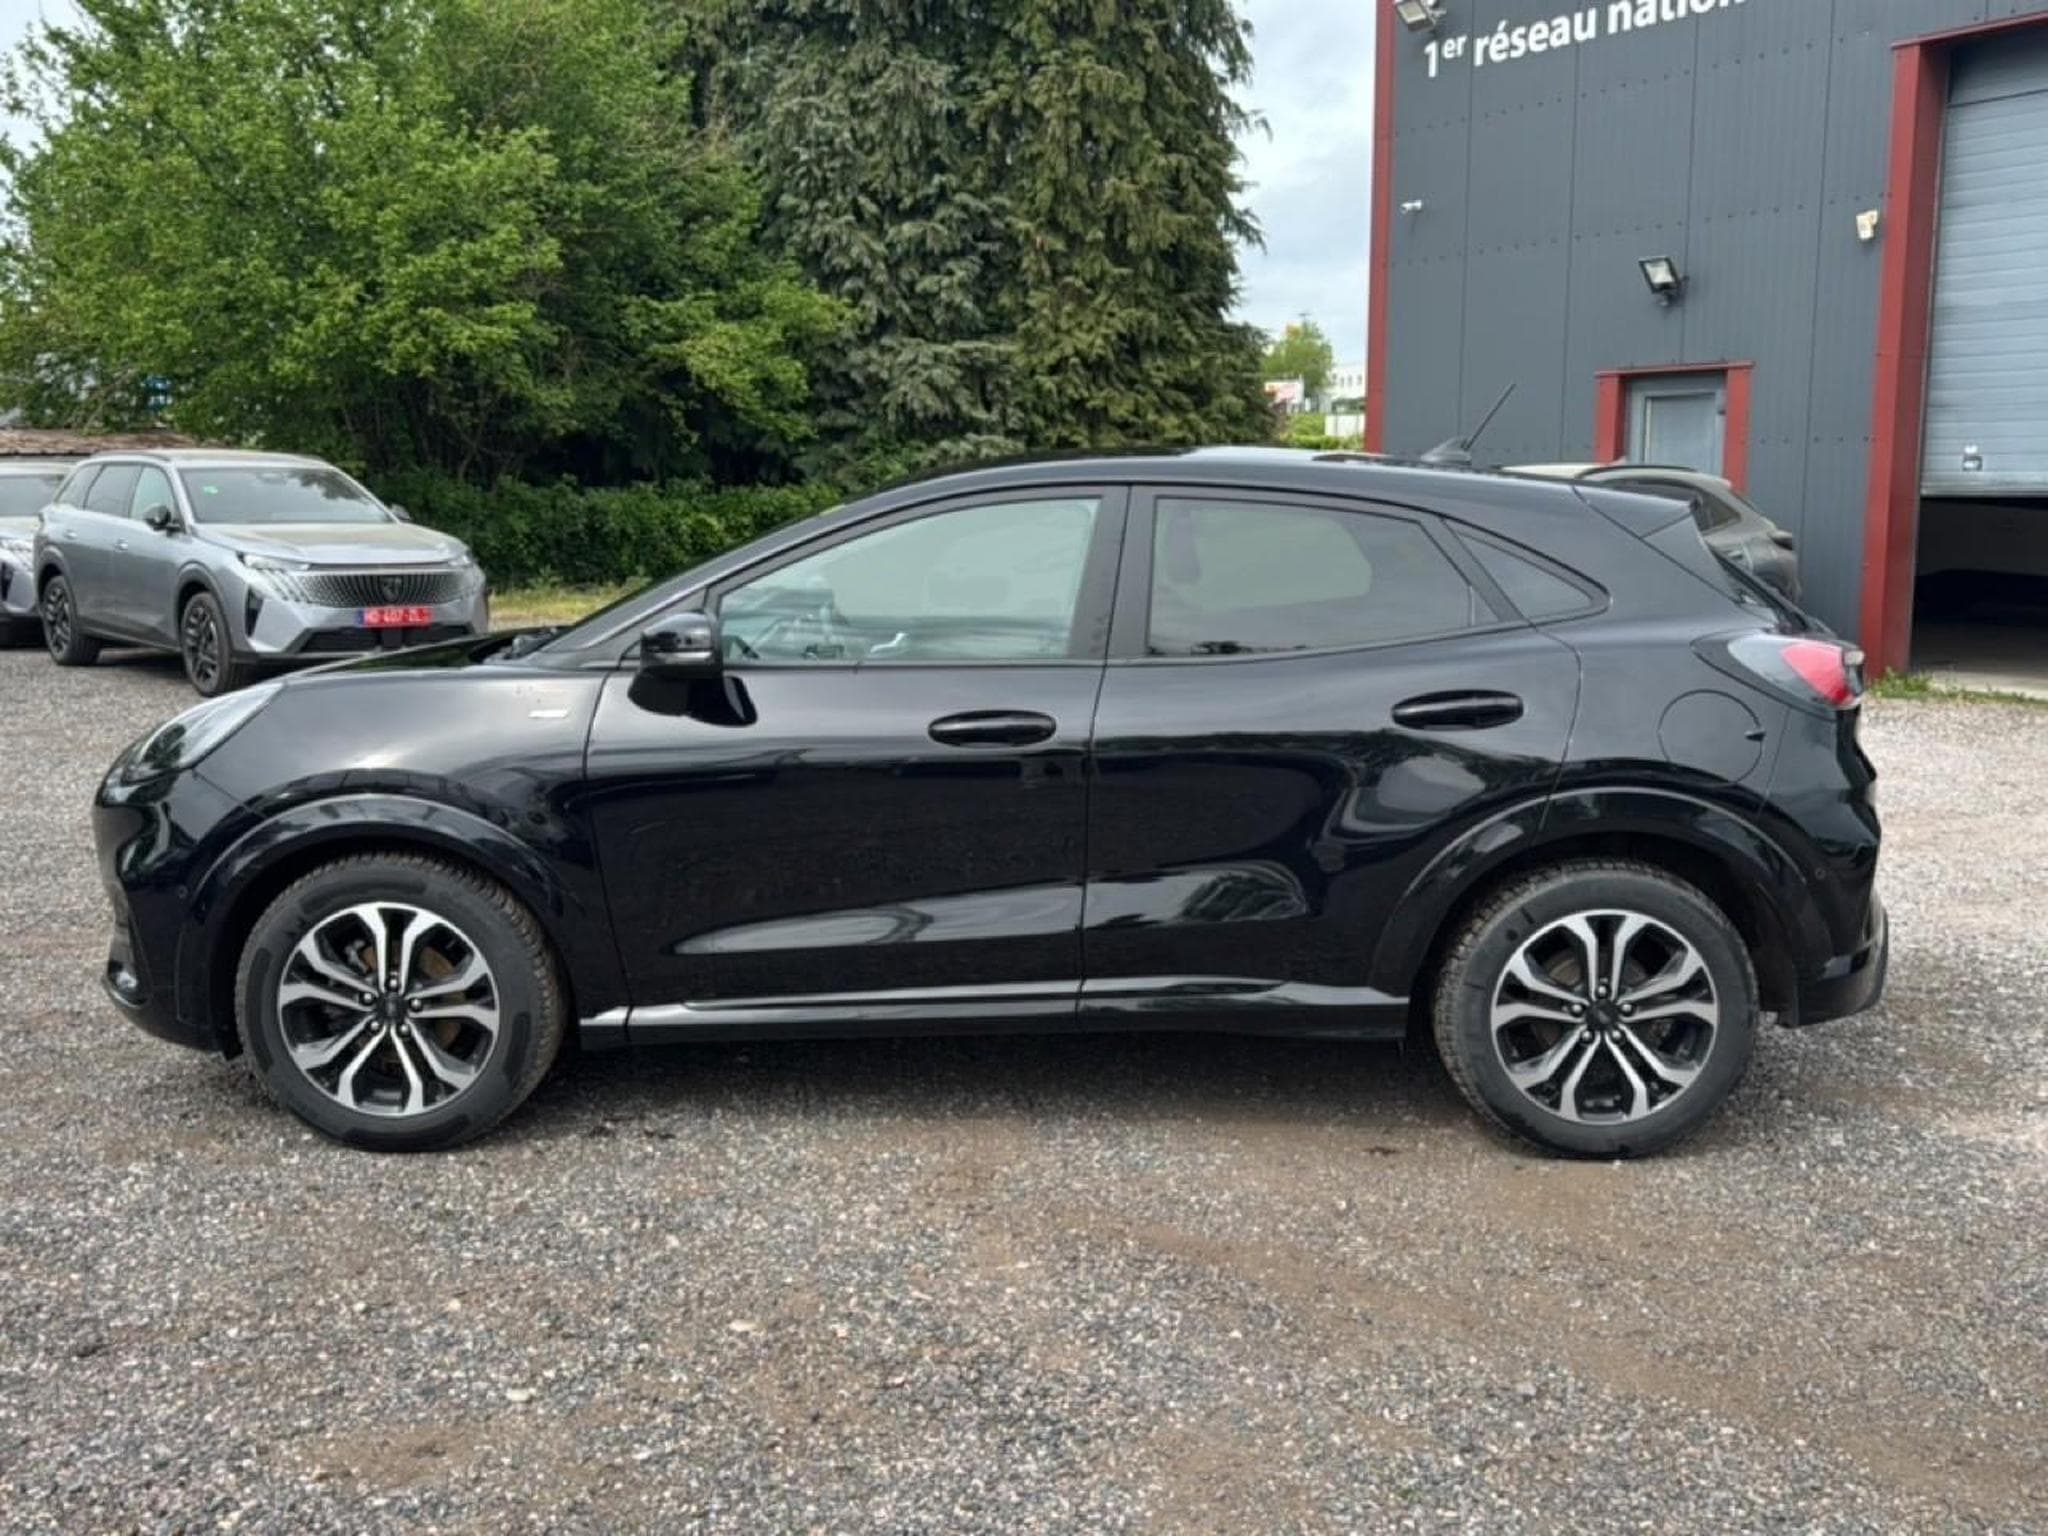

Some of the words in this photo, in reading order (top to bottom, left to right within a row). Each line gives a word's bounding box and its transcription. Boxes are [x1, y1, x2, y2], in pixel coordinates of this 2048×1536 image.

[1424, 35, 1467, 78] 1er
[1473, 8, 1598, 67] réseau
[1606, 0, 1745, 34] nati
